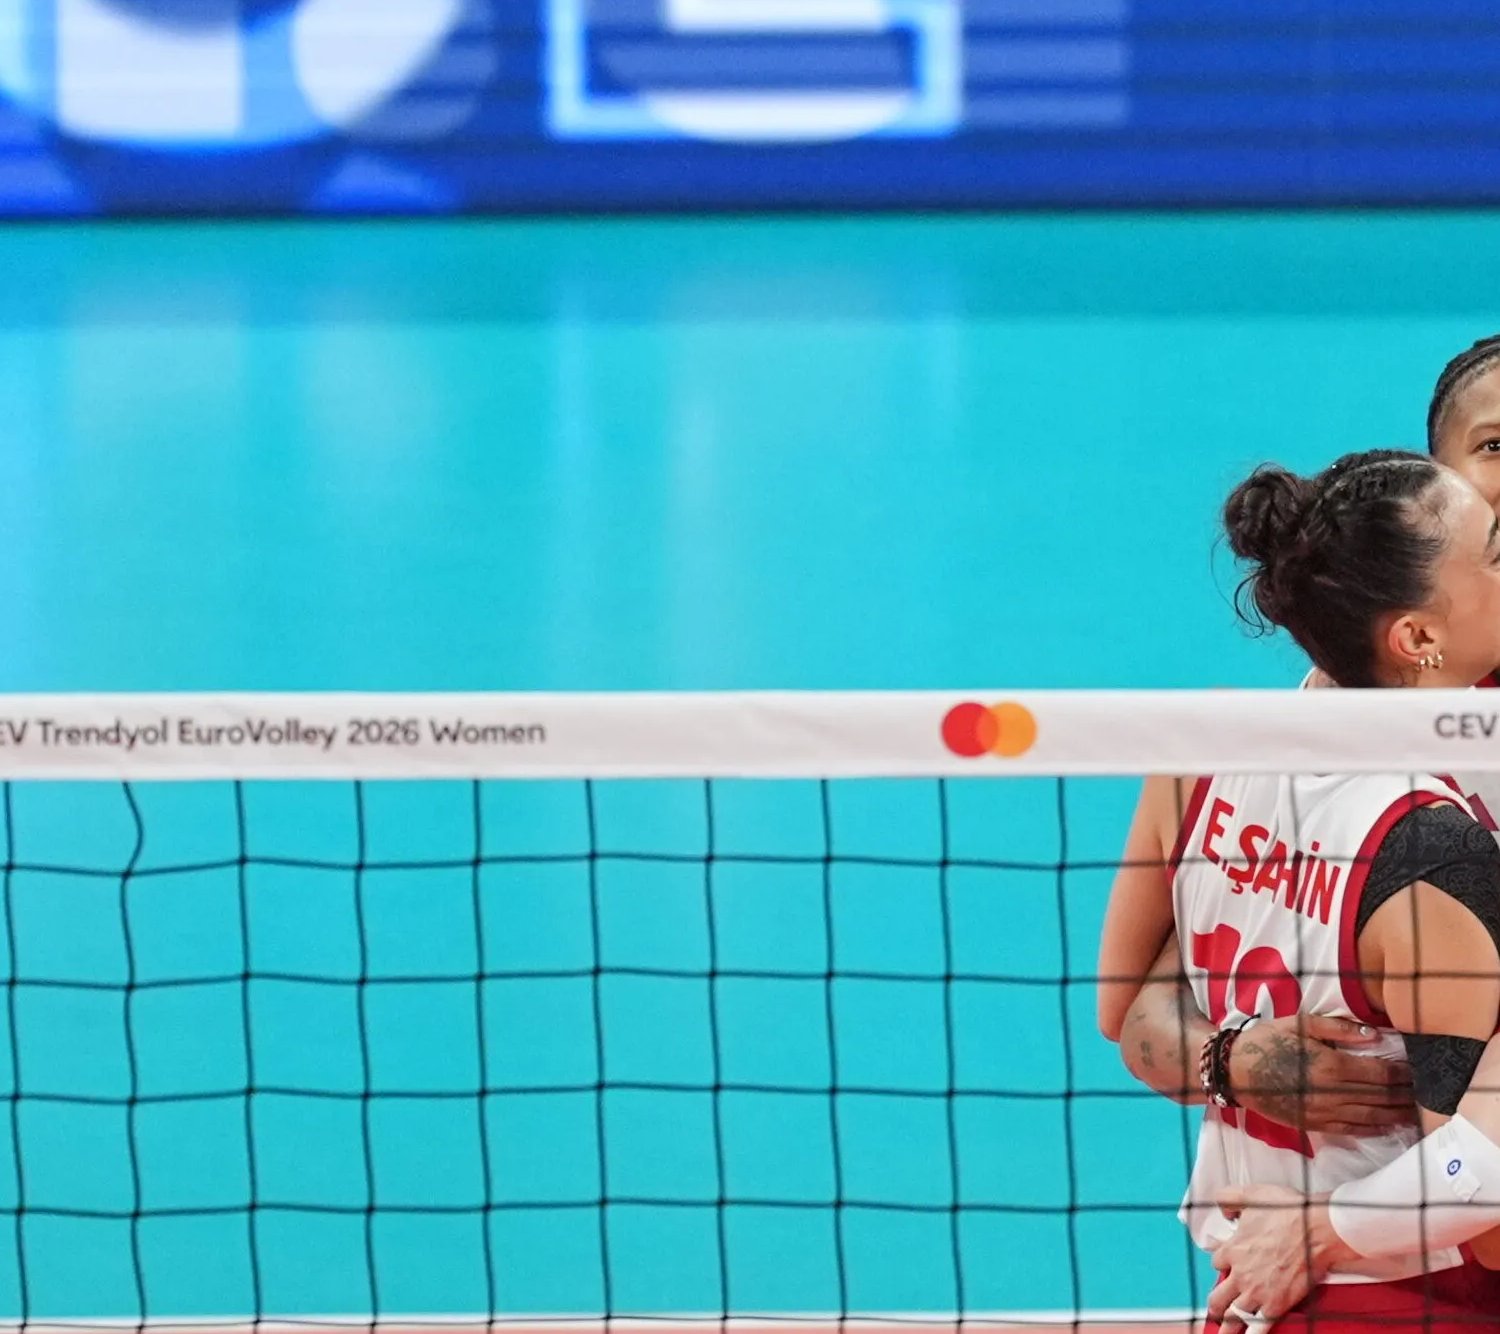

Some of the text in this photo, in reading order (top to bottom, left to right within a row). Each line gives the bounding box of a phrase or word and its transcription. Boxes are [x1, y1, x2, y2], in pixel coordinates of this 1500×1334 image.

[38, 719, 167, 750] Trendyol
[179, 719, 336, 750] EuroVolley
[348, 720, 419, 745] 2026
[430, 720, 545, 744] Women
[1435, 713, 1497, 738] CEV
